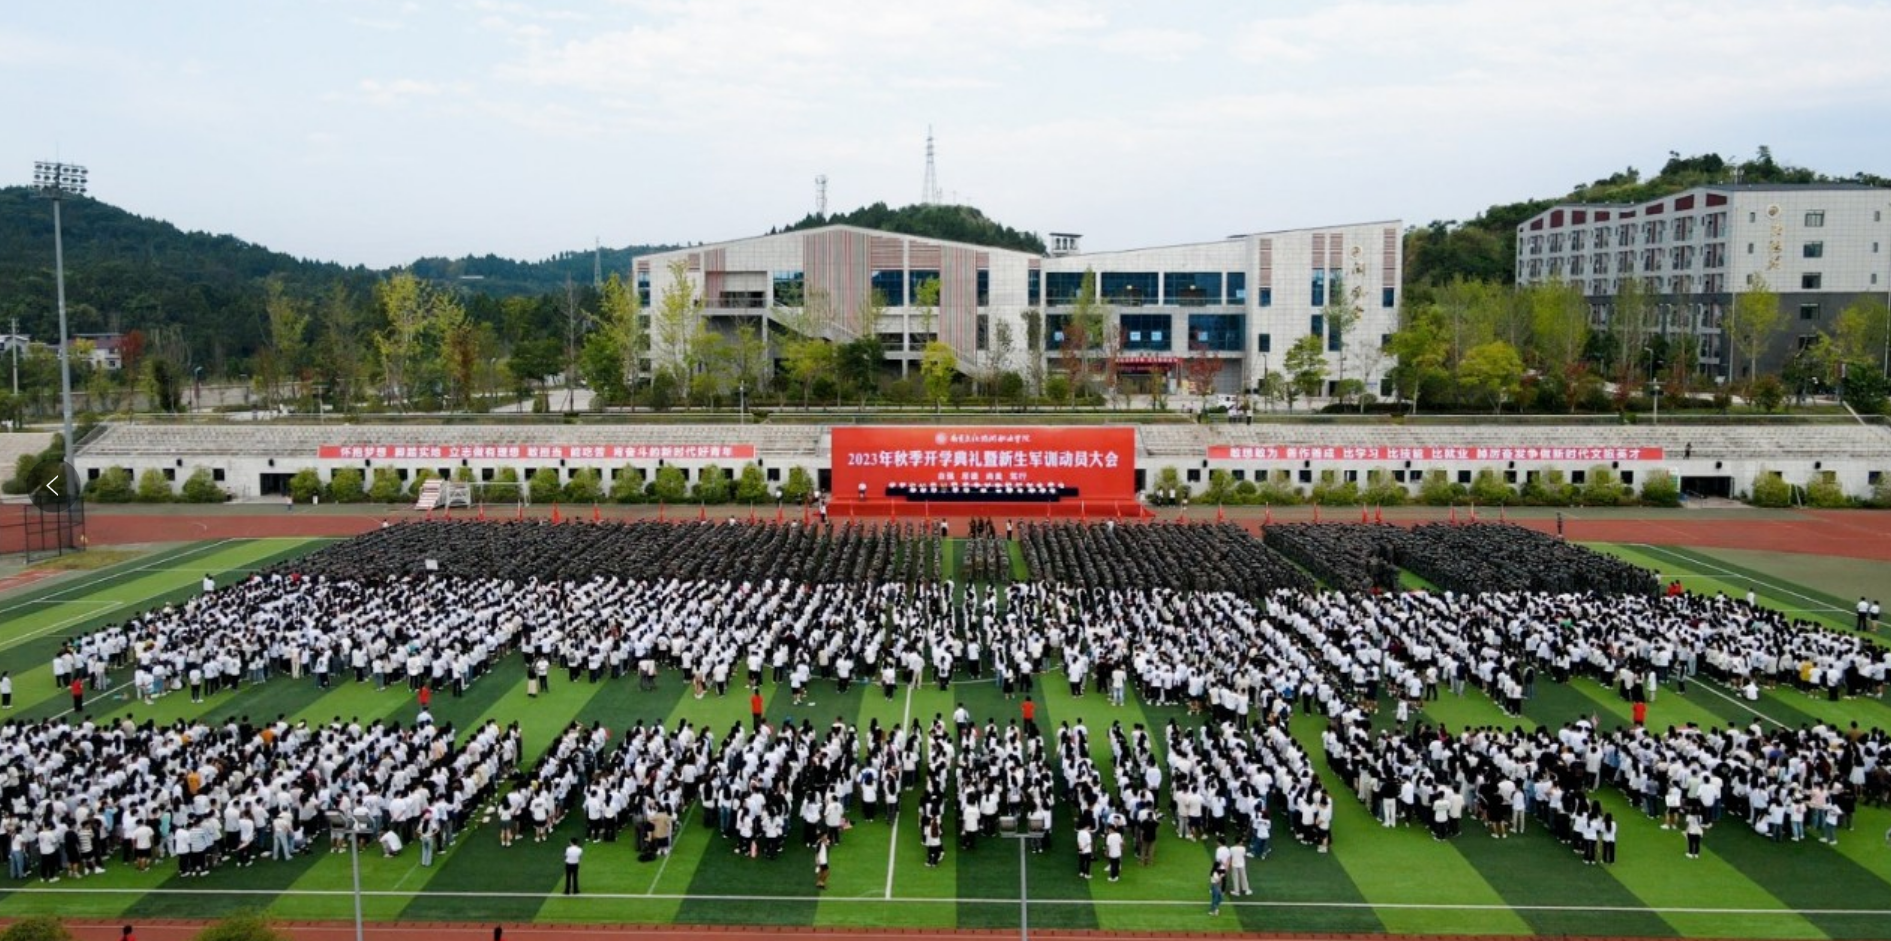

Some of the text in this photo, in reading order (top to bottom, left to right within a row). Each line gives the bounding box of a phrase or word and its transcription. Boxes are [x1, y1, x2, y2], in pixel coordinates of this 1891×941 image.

[847, 450, 1119, 468] 2023年秋季开学典礼暨新生军训动员大会
[1343, 447, 1379, 459] 比学习
